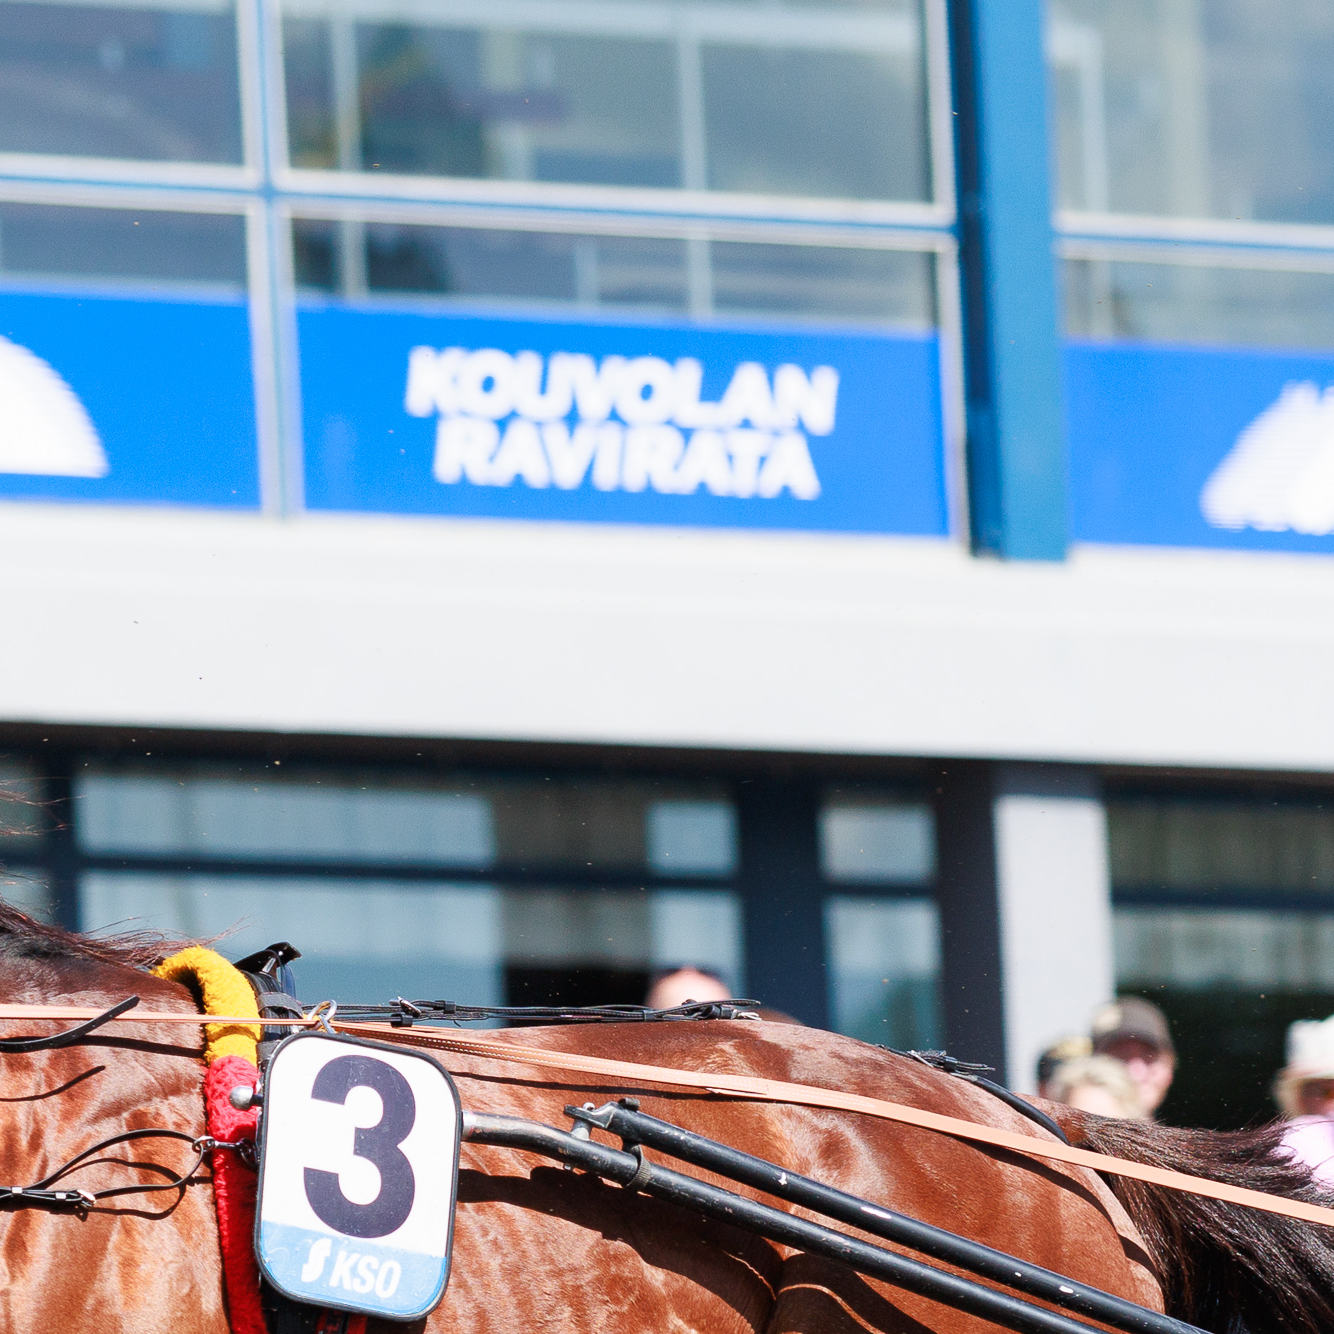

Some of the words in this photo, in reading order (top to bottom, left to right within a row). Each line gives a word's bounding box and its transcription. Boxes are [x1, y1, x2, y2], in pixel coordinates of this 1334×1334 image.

[405, 345, 839, 436] KOUVOLAN
[434, 415, 821, 500] RAVIRATA
[303, 1055, 416, 1238] 3
[329, 1250, 402, 1298] KSO
